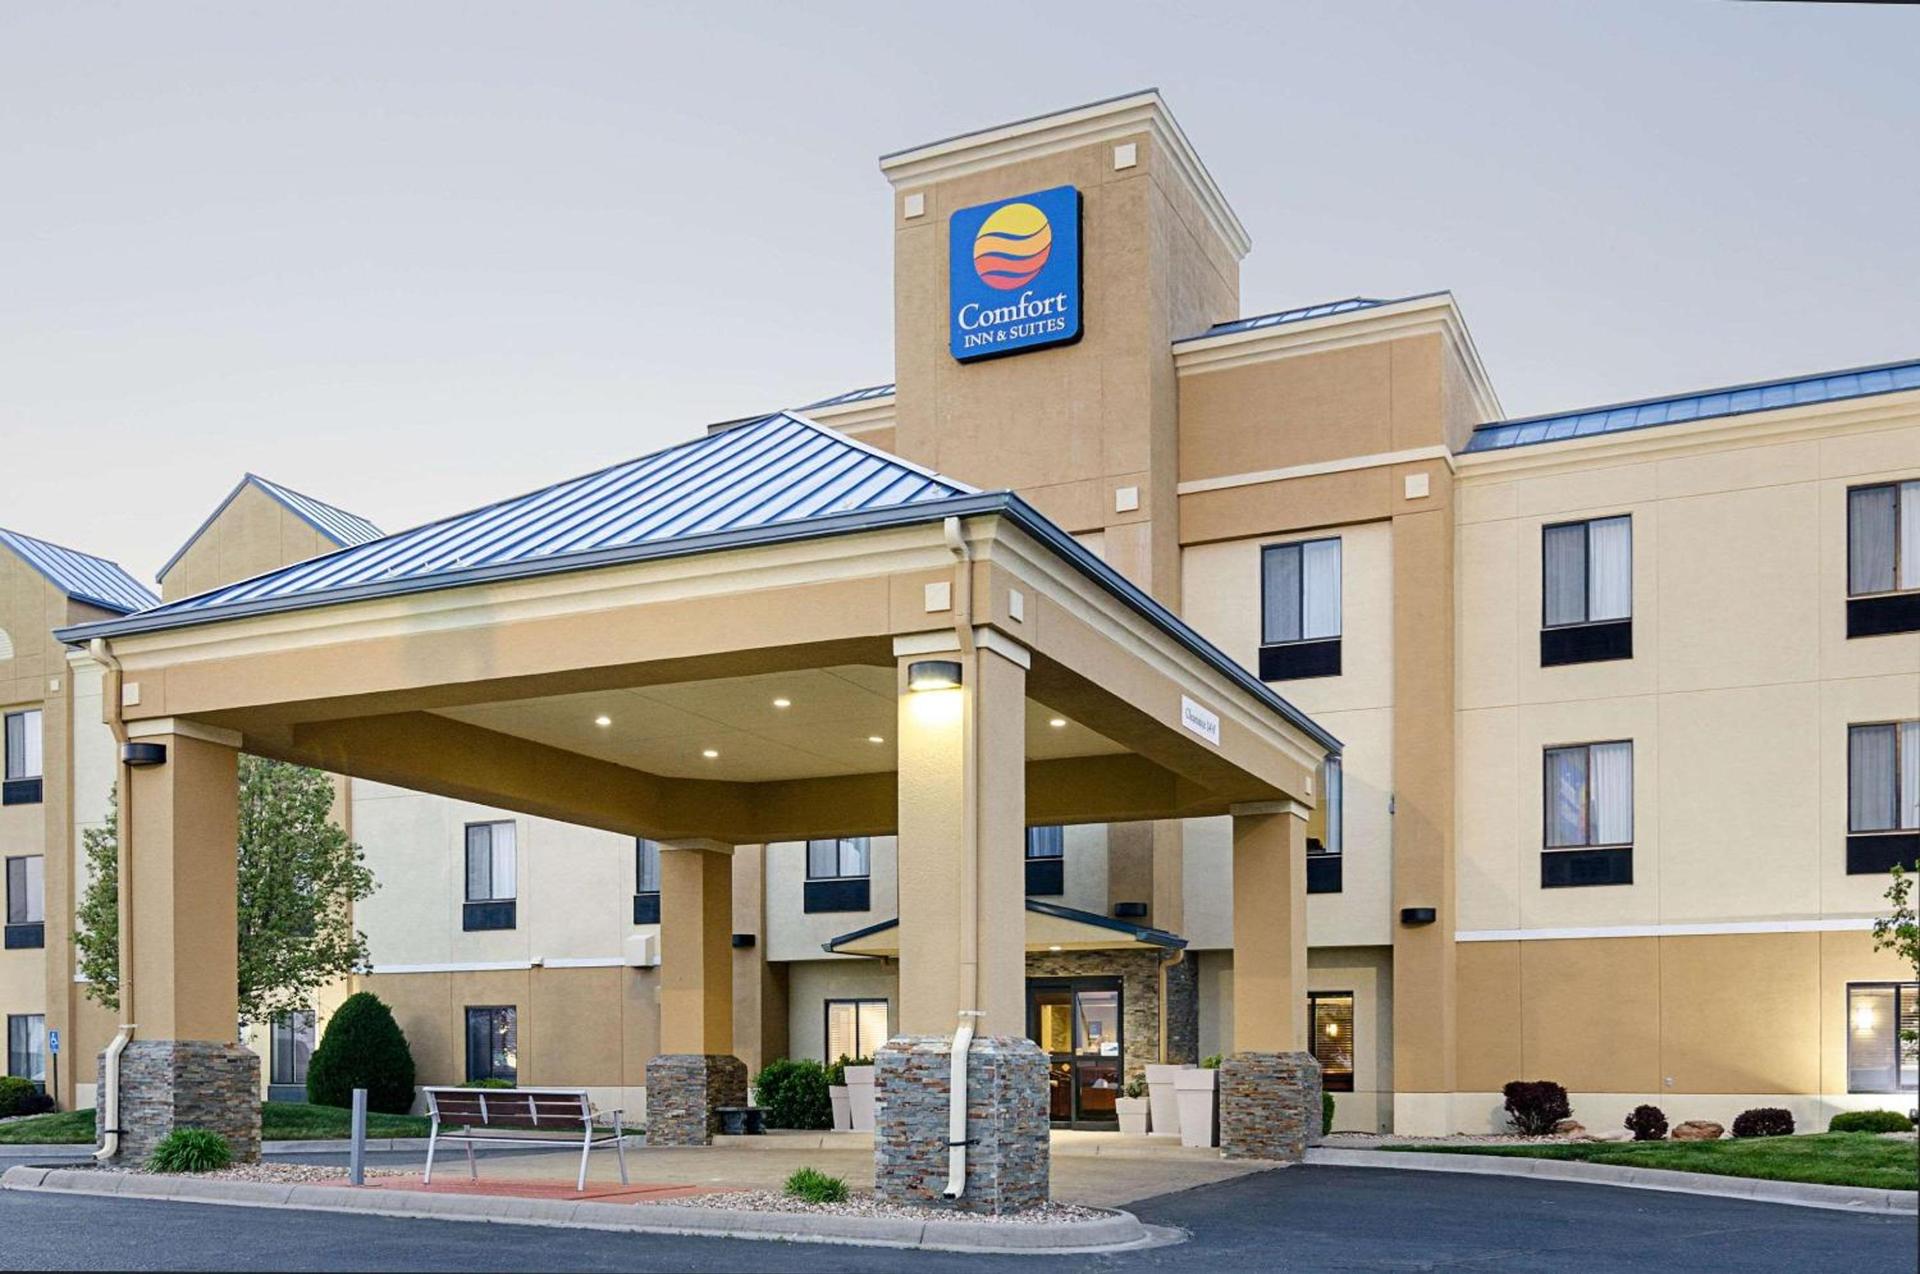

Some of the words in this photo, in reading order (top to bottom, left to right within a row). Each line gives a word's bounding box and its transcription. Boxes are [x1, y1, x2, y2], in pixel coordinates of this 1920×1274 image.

[958, 291, 1067, 330] Comfort
[964, 331, 993, 348] INN
[997, 330, 1007, 341] &
[1009, 317, 1066, 339] SUITES
